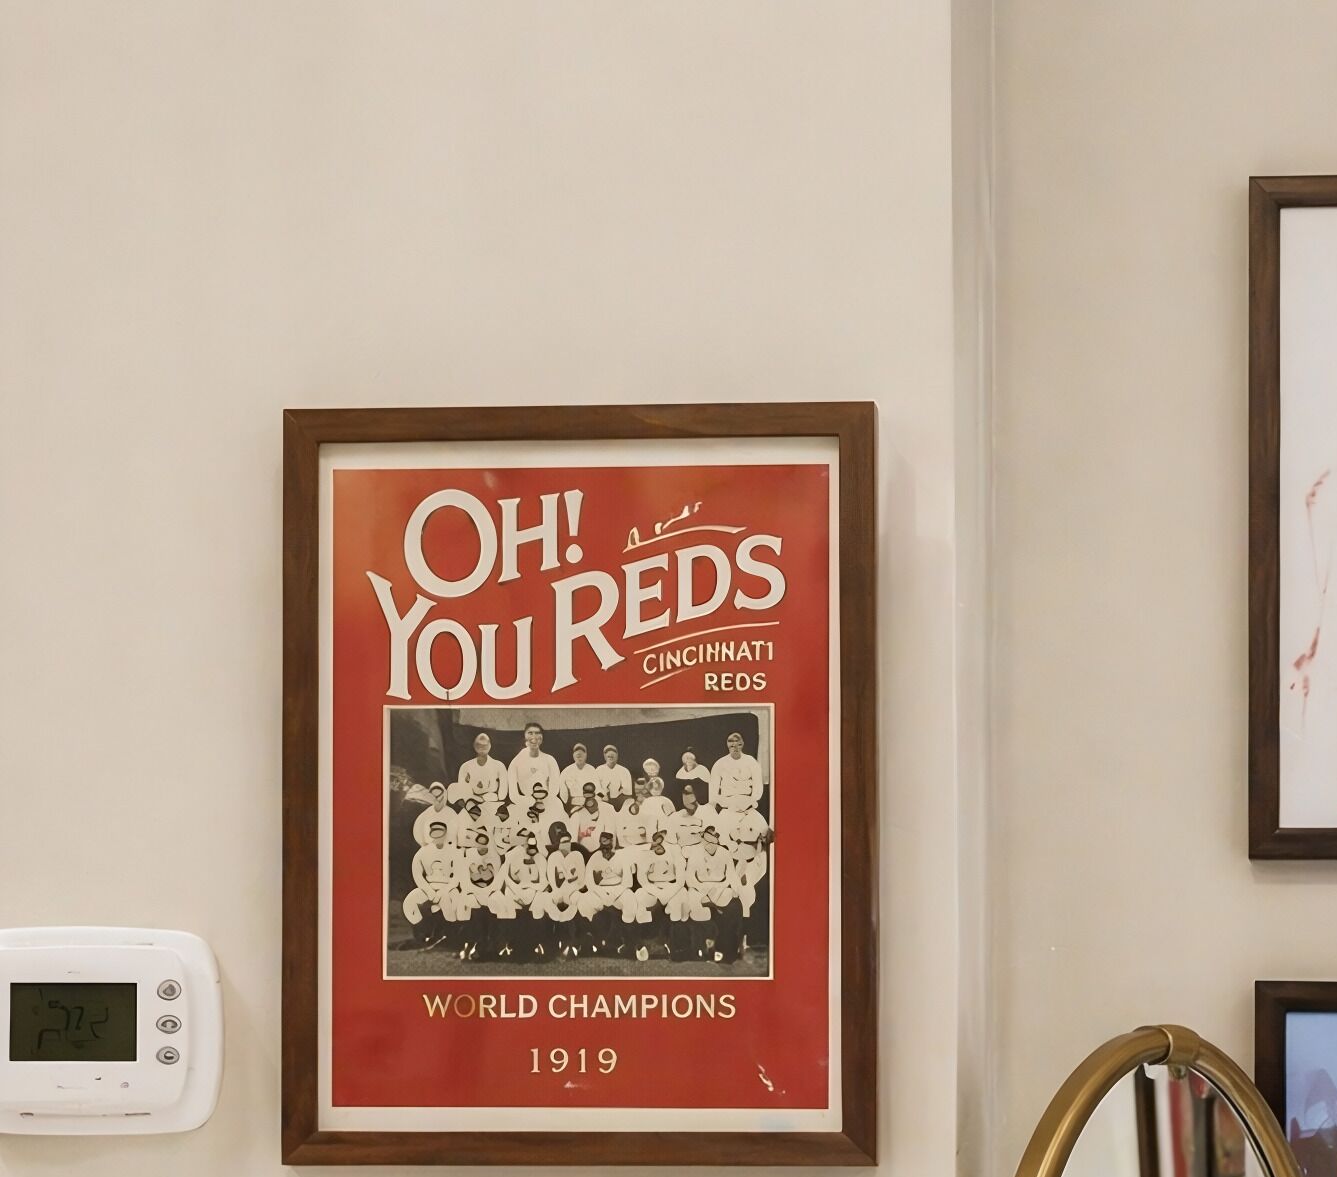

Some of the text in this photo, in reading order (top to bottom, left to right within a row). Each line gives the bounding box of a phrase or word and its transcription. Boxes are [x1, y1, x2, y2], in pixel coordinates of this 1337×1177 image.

[404, 489, 584, 598] OH!
[366, 535, 786, 700] YOU REDS
[704, 672, 768, 692] REDS
[422, 993, 736, 1019] WORLD CHAMPIONS
[530, 1048, 618, 1074] 1919
